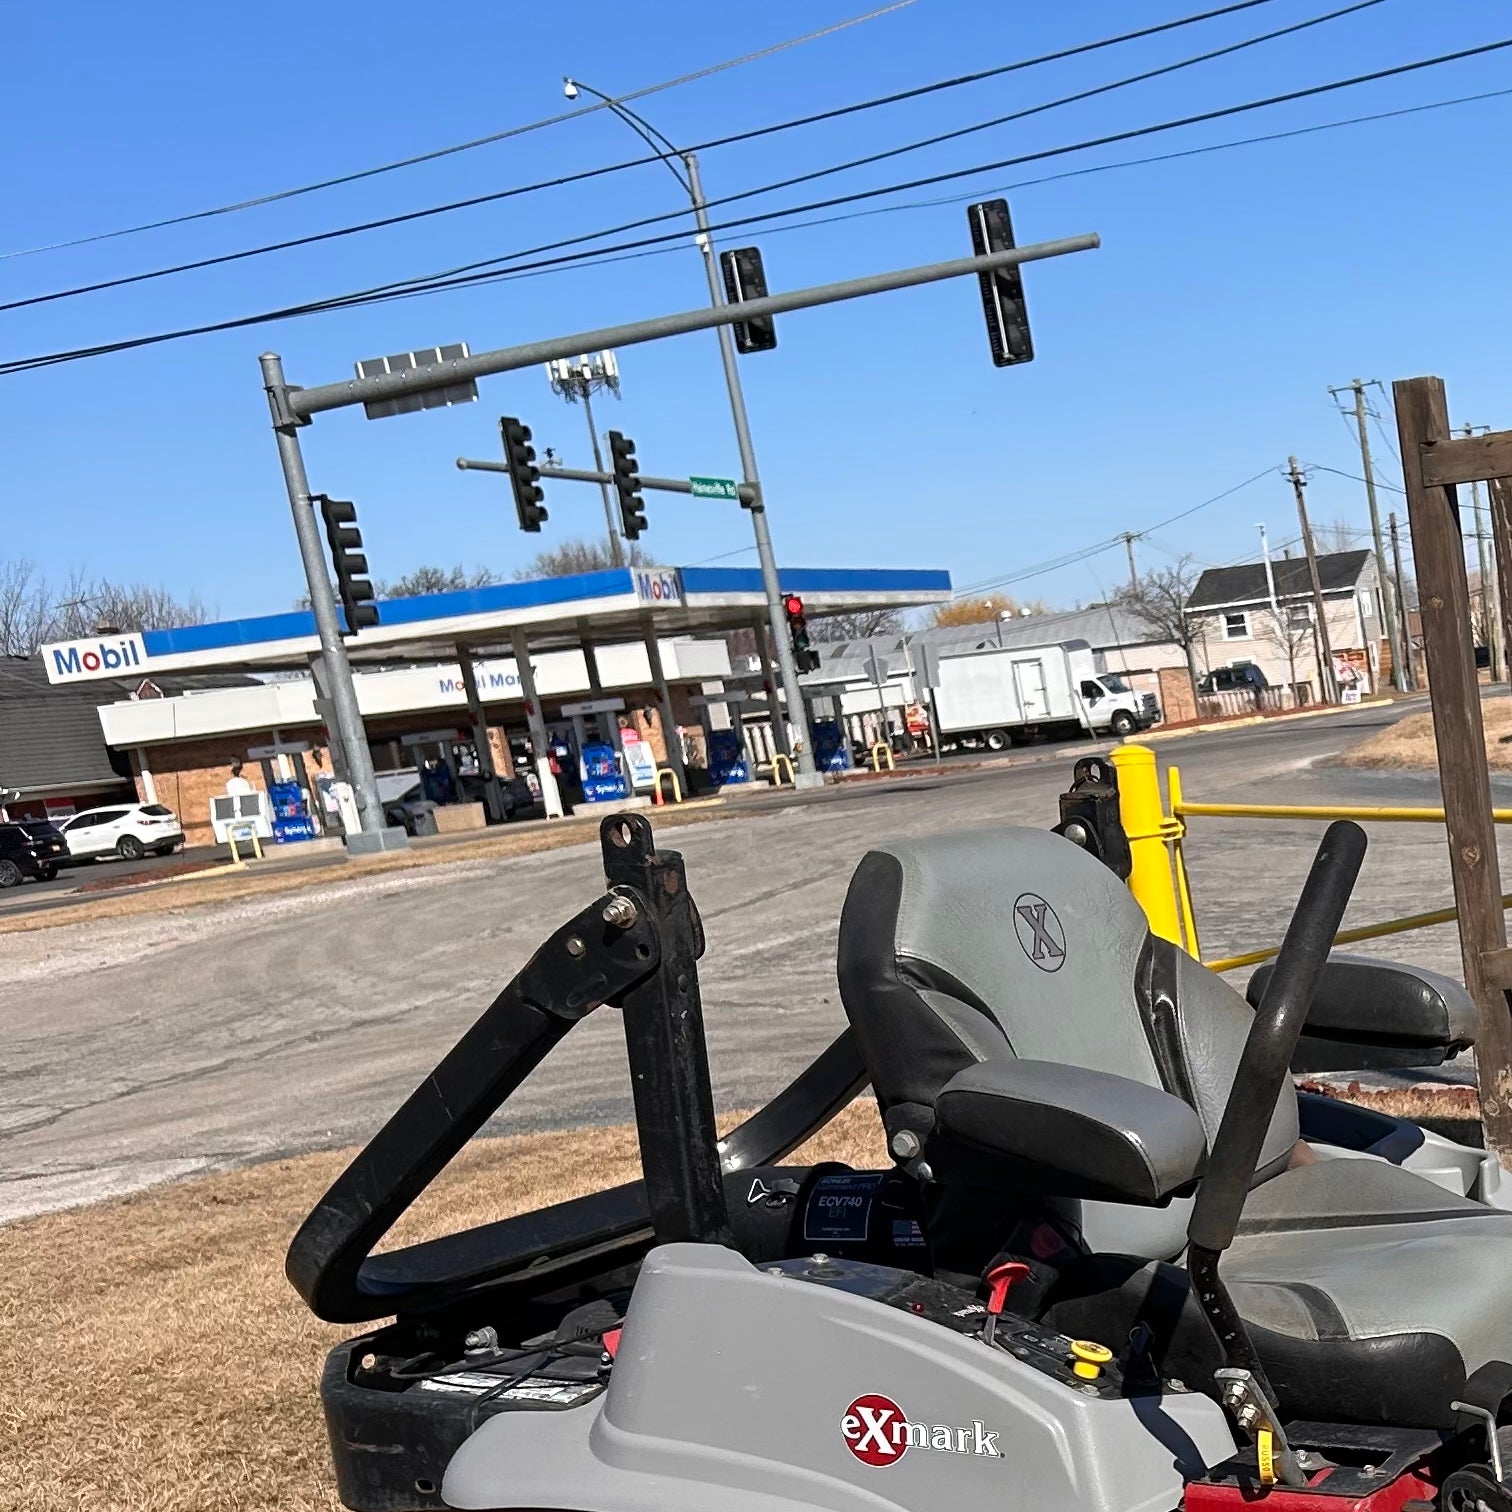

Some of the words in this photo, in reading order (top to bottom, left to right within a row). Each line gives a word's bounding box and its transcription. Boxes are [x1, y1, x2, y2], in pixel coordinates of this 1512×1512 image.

[637, 572, 681, 600] Mobil
[53, 640, 140, 675] Mobil
[439, 675, 486, 693] Moil
[818, 1195, 863, 1207] ECV740
[839, 1405, 1001, 1458] eXmark
